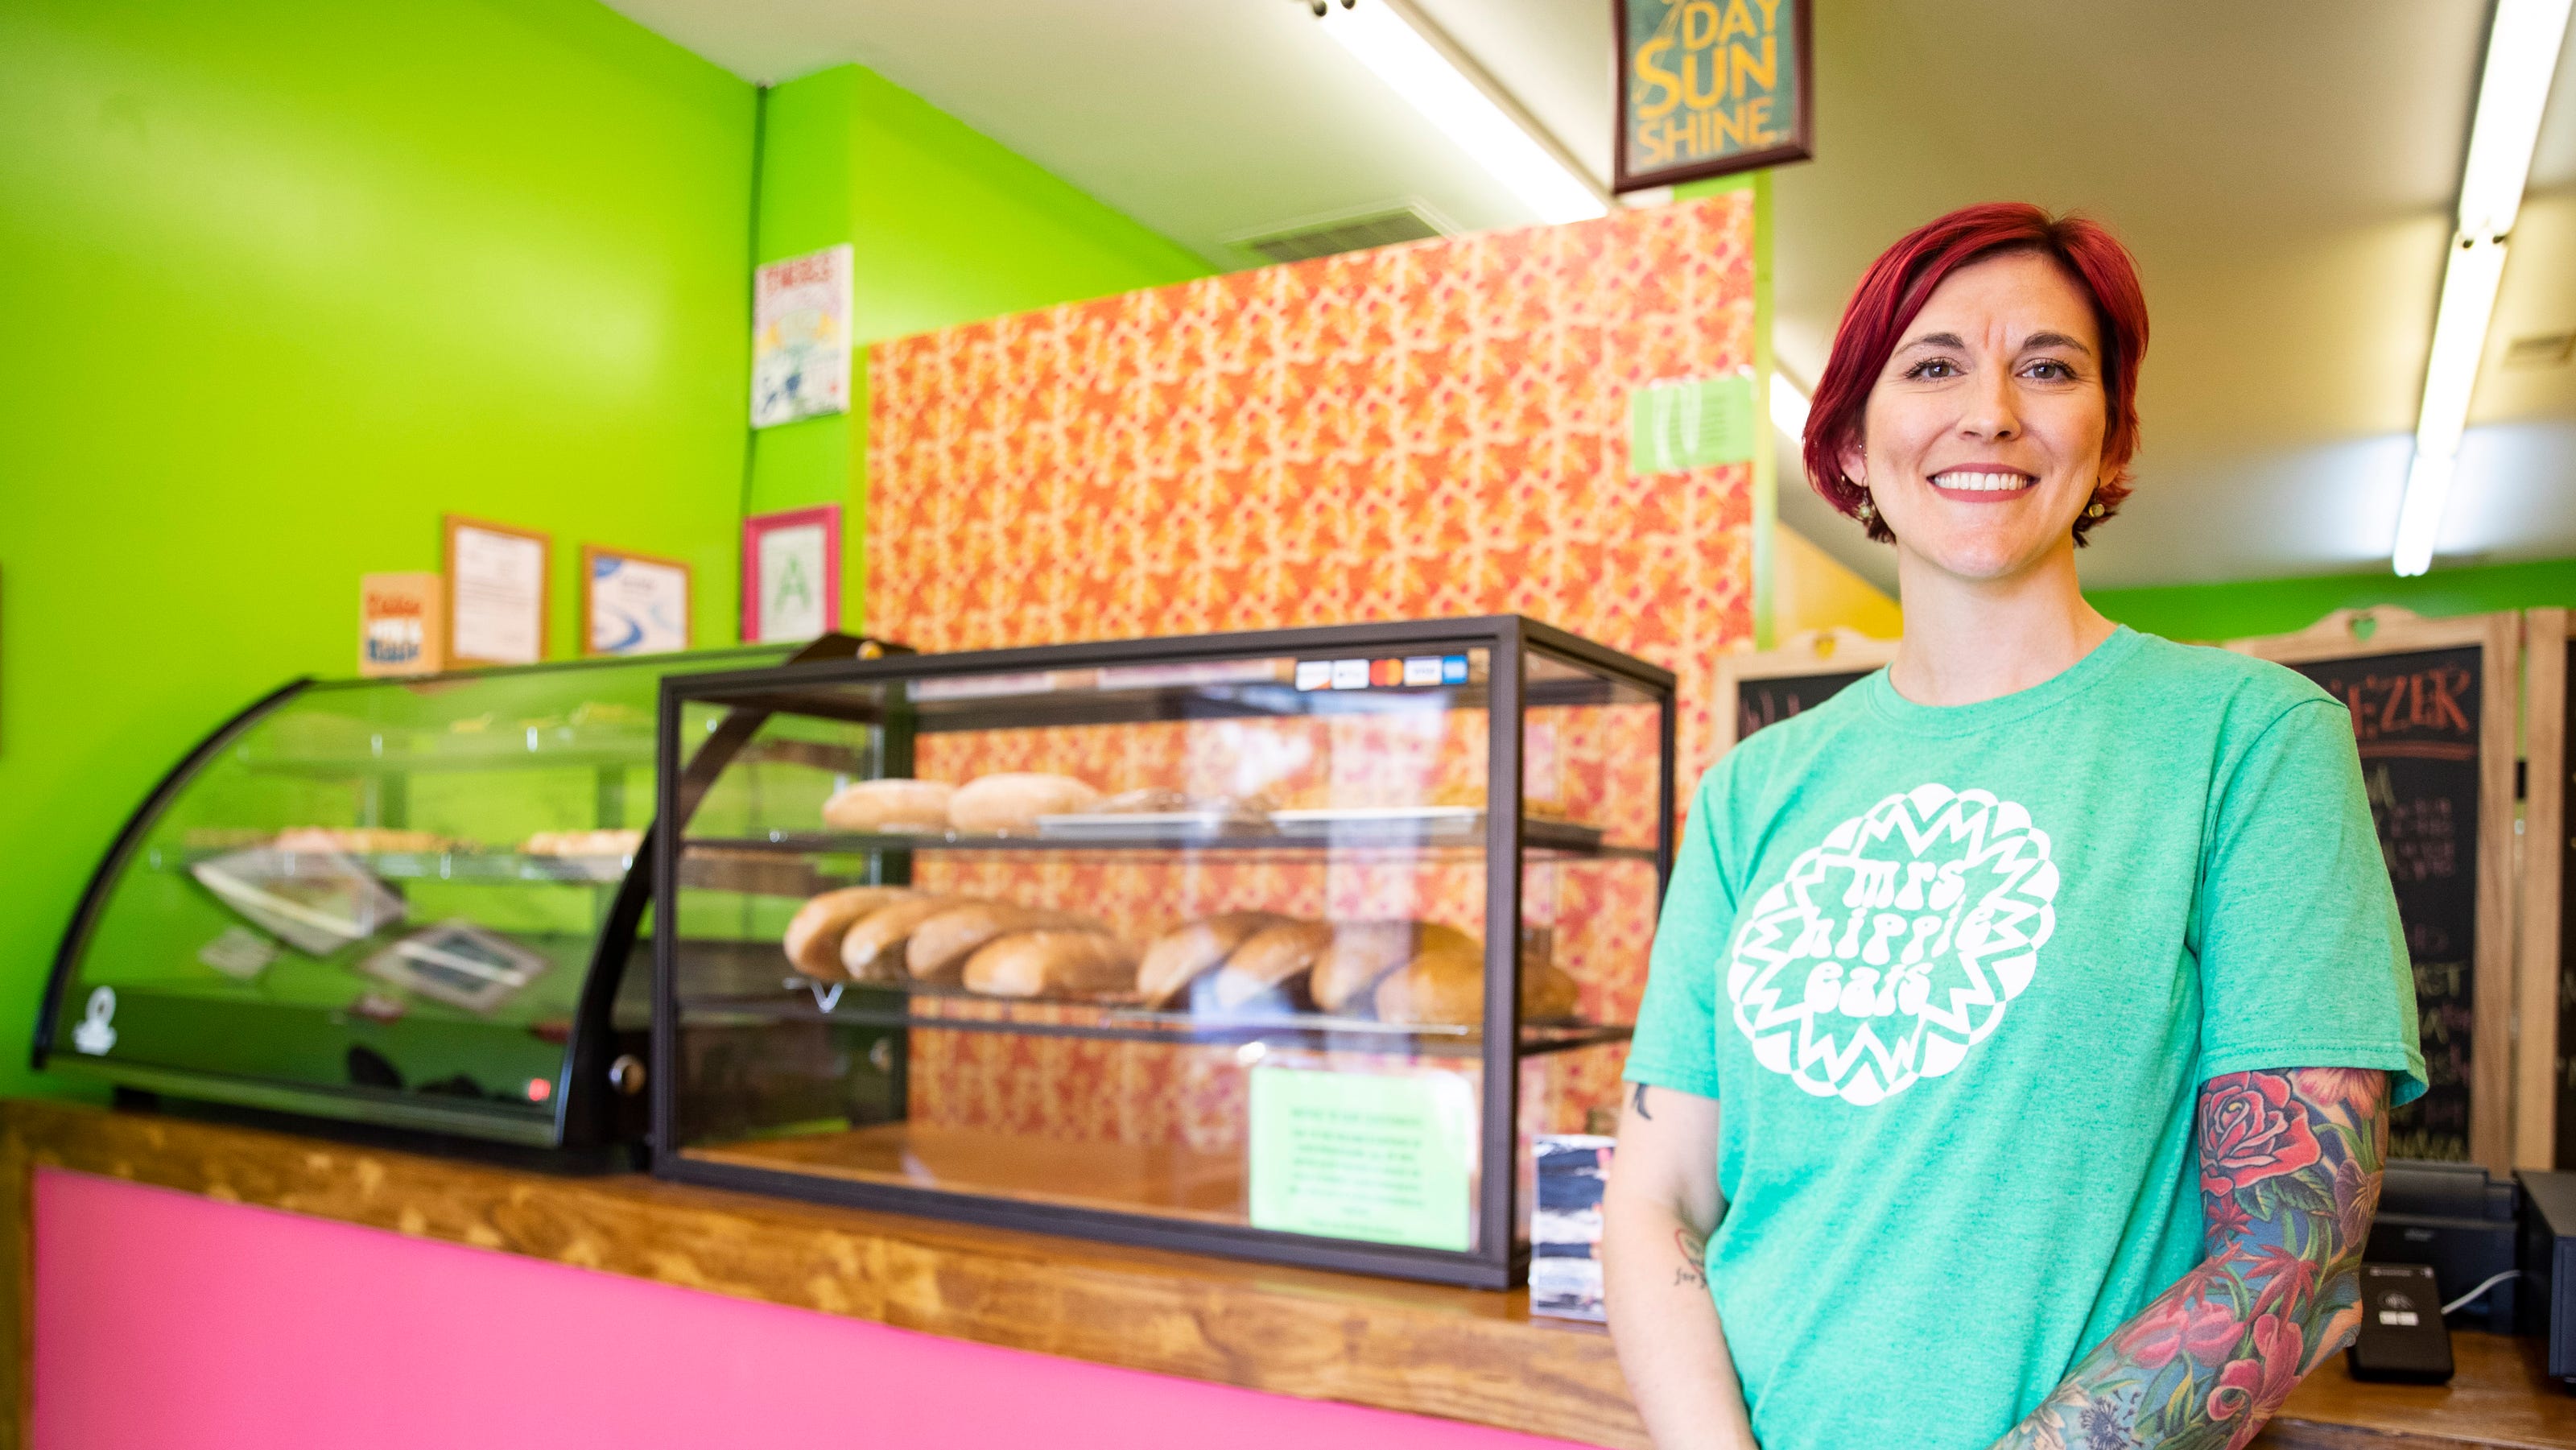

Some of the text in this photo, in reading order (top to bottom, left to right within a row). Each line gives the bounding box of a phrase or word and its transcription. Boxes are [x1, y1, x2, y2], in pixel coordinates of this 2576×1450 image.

[1682, 0, 1781, 51] DAY
[1634, 35, 1777, 121] SUN
[1637, 96, 1777, 165] SHINE
[2330, 663, 2471, 742] EZER
[1842, 858, 1966, 911] mrs
[1787, 894, 1996, 965] hippie
[1804, 961, 1934, 1018] eats
